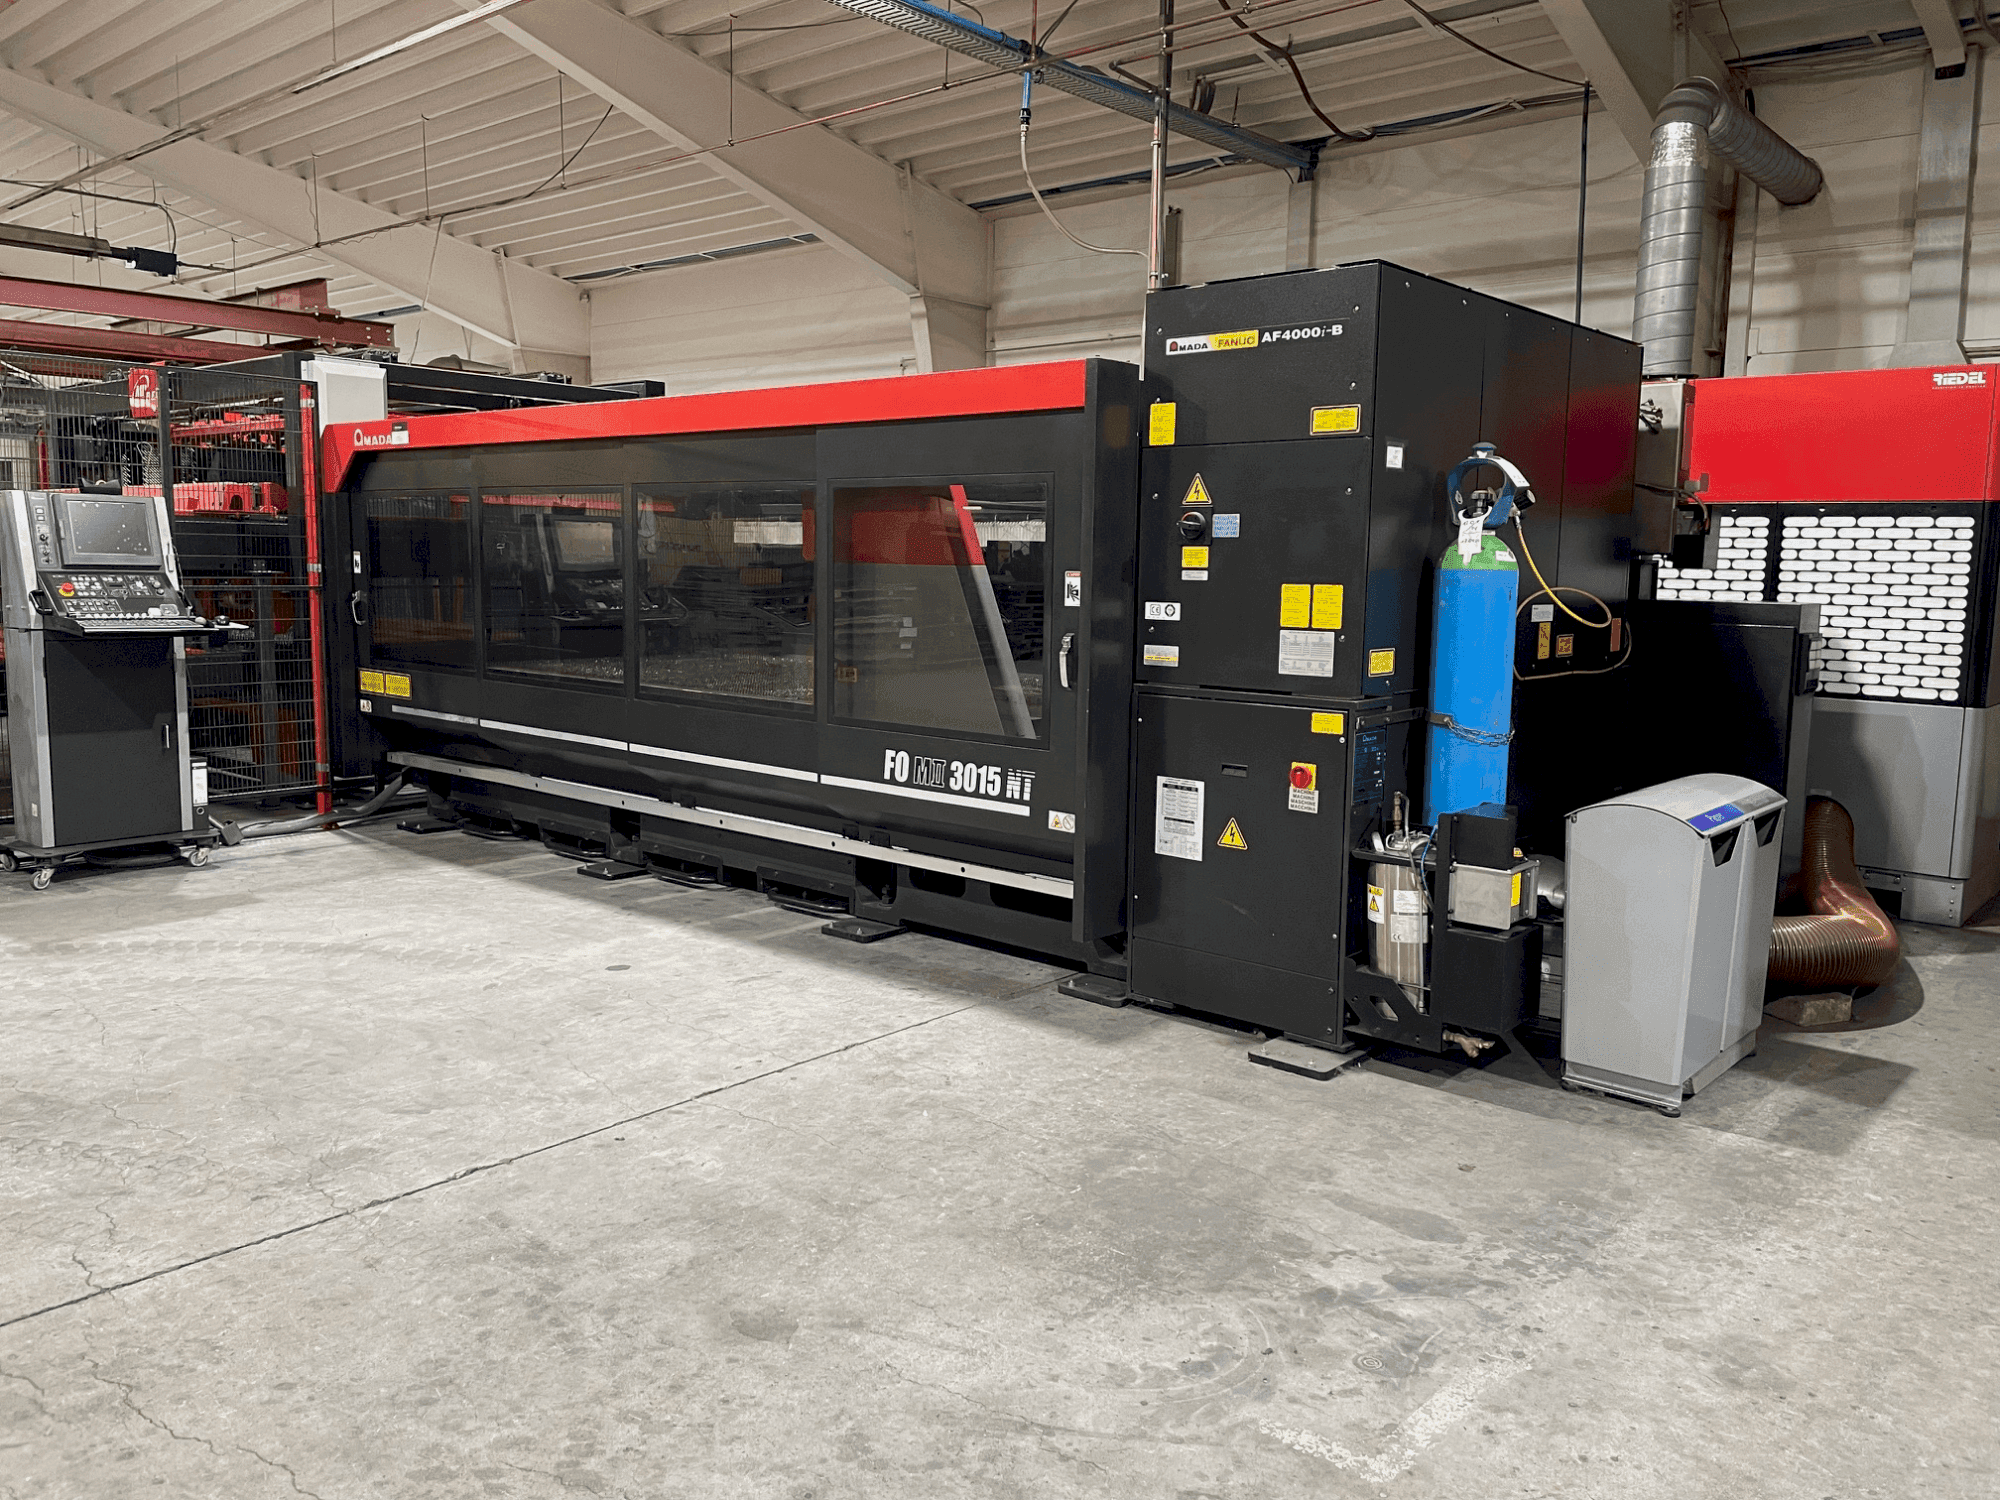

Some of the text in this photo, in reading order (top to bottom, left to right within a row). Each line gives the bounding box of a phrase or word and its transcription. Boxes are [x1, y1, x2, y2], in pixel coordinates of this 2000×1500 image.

[1218, 335, 1256, 348] FANUC
[1261, 324, 1343, 343] AF4000i-B
[1933, 371, 1987, 386] RIEDEL
[883, 749, 910, 783] FO
[949, 760, 1002, 797] 3015
[1006, 768, 1036, 801] NT
